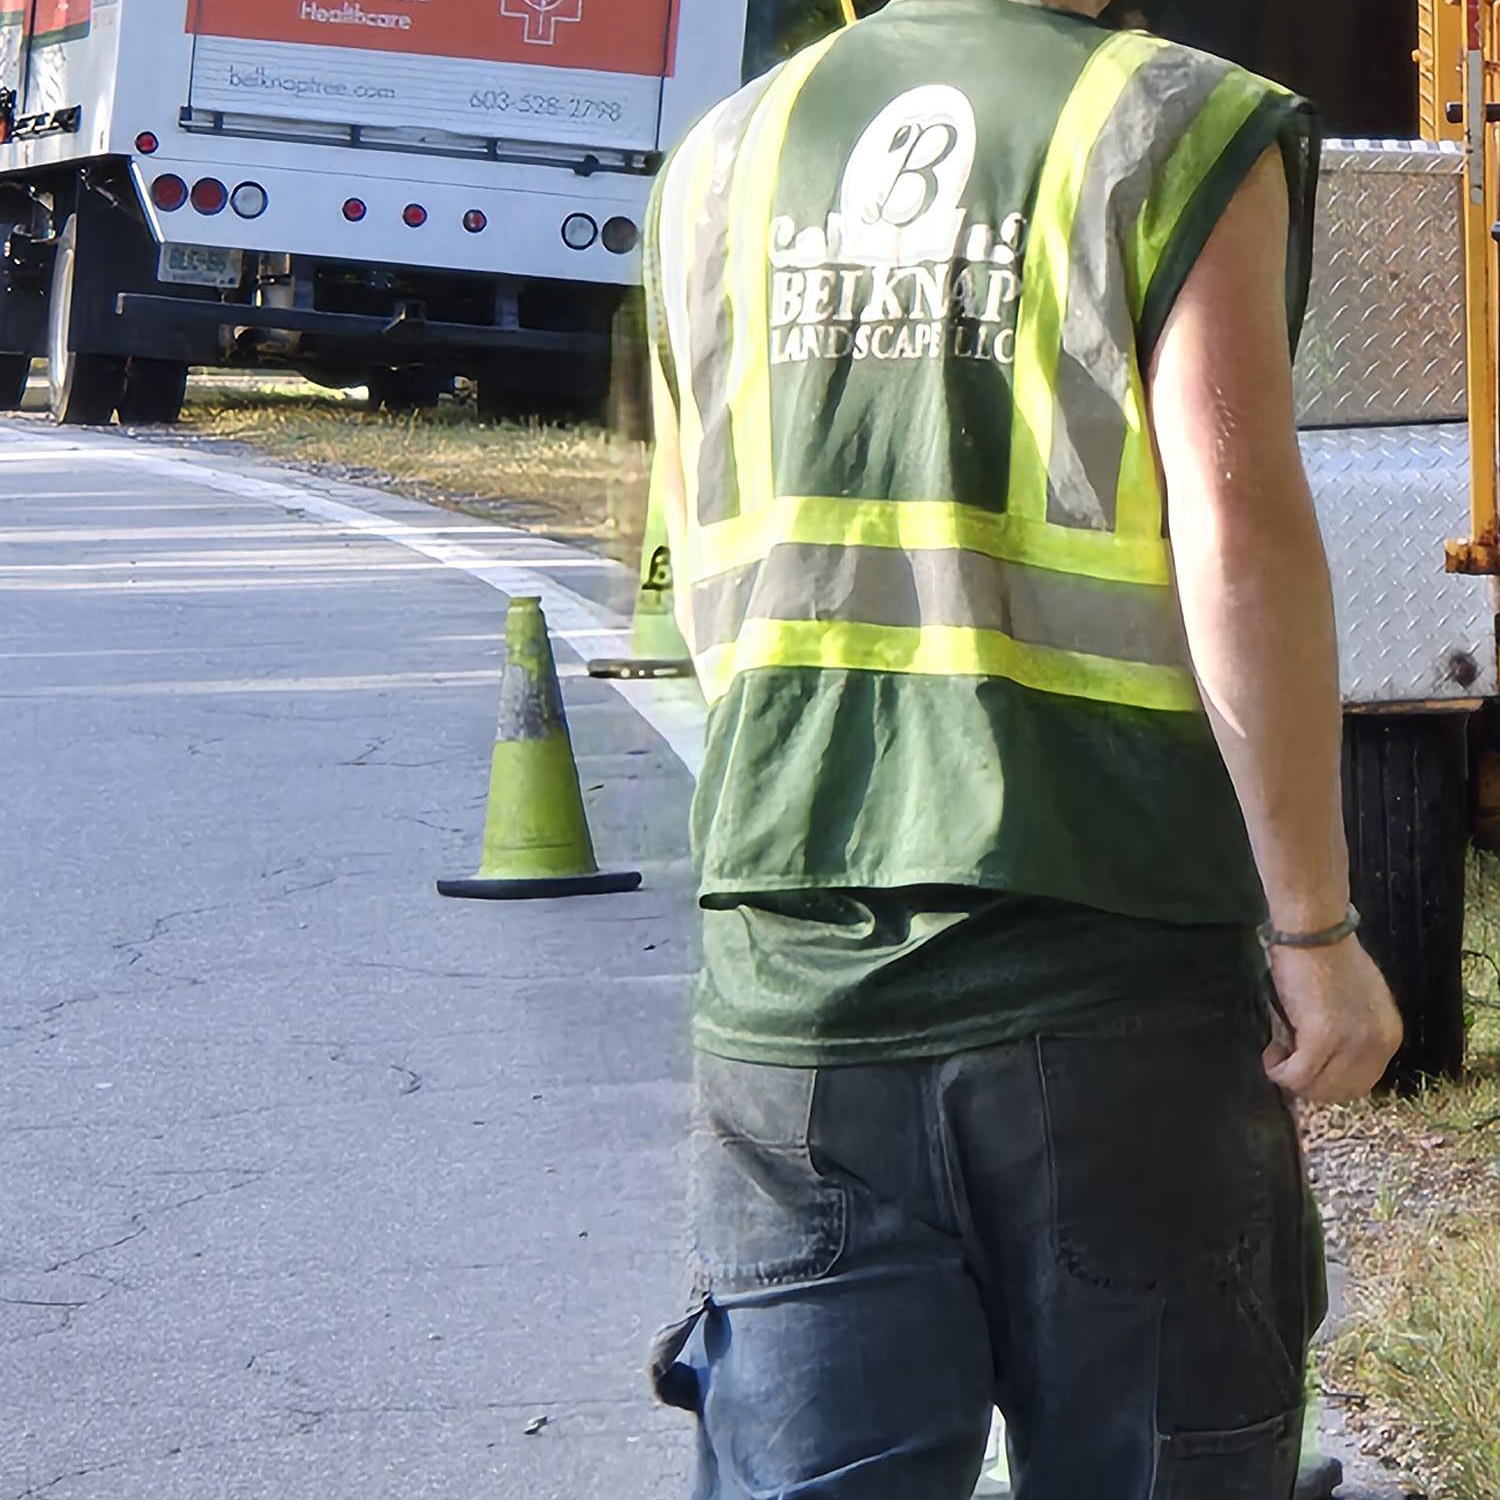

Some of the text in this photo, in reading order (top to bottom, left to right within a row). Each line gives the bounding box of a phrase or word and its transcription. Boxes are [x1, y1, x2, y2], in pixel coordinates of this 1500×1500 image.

[300, 0, 412, 30] Healthcare
[229, 65, 396, 99] belknaptree.com
[770, 324, 1016, 365] LANDSCAPE LLC
